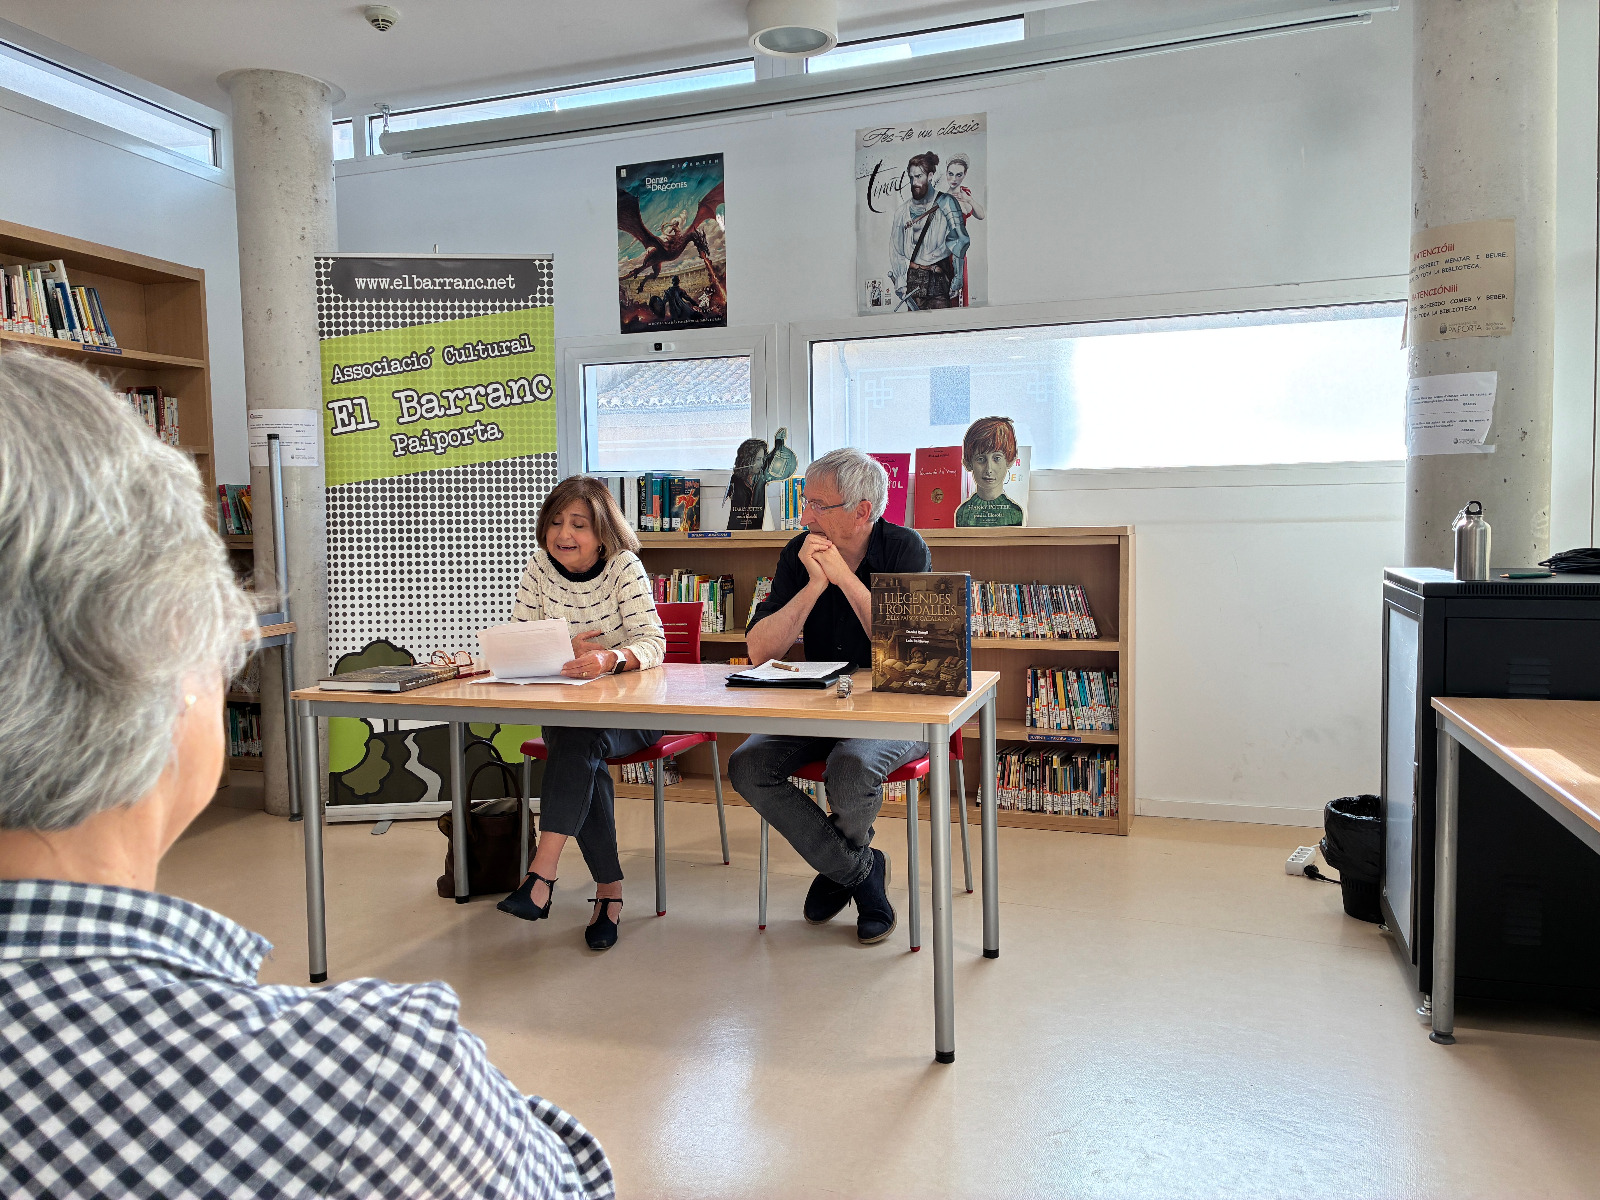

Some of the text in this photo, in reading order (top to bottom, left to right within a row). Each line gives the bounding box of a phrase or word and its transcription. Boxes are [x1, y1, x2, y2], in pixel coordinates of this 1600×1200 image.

[355, 274, 516, 290] www.elbarranc.net
[332, 333, 534, 383] Associació Cultural
[327, 374, 553, 435] El Barranc
[391, 420, 504, 457] Paiporta
[886, 603, 957, 616] RONDALLES
